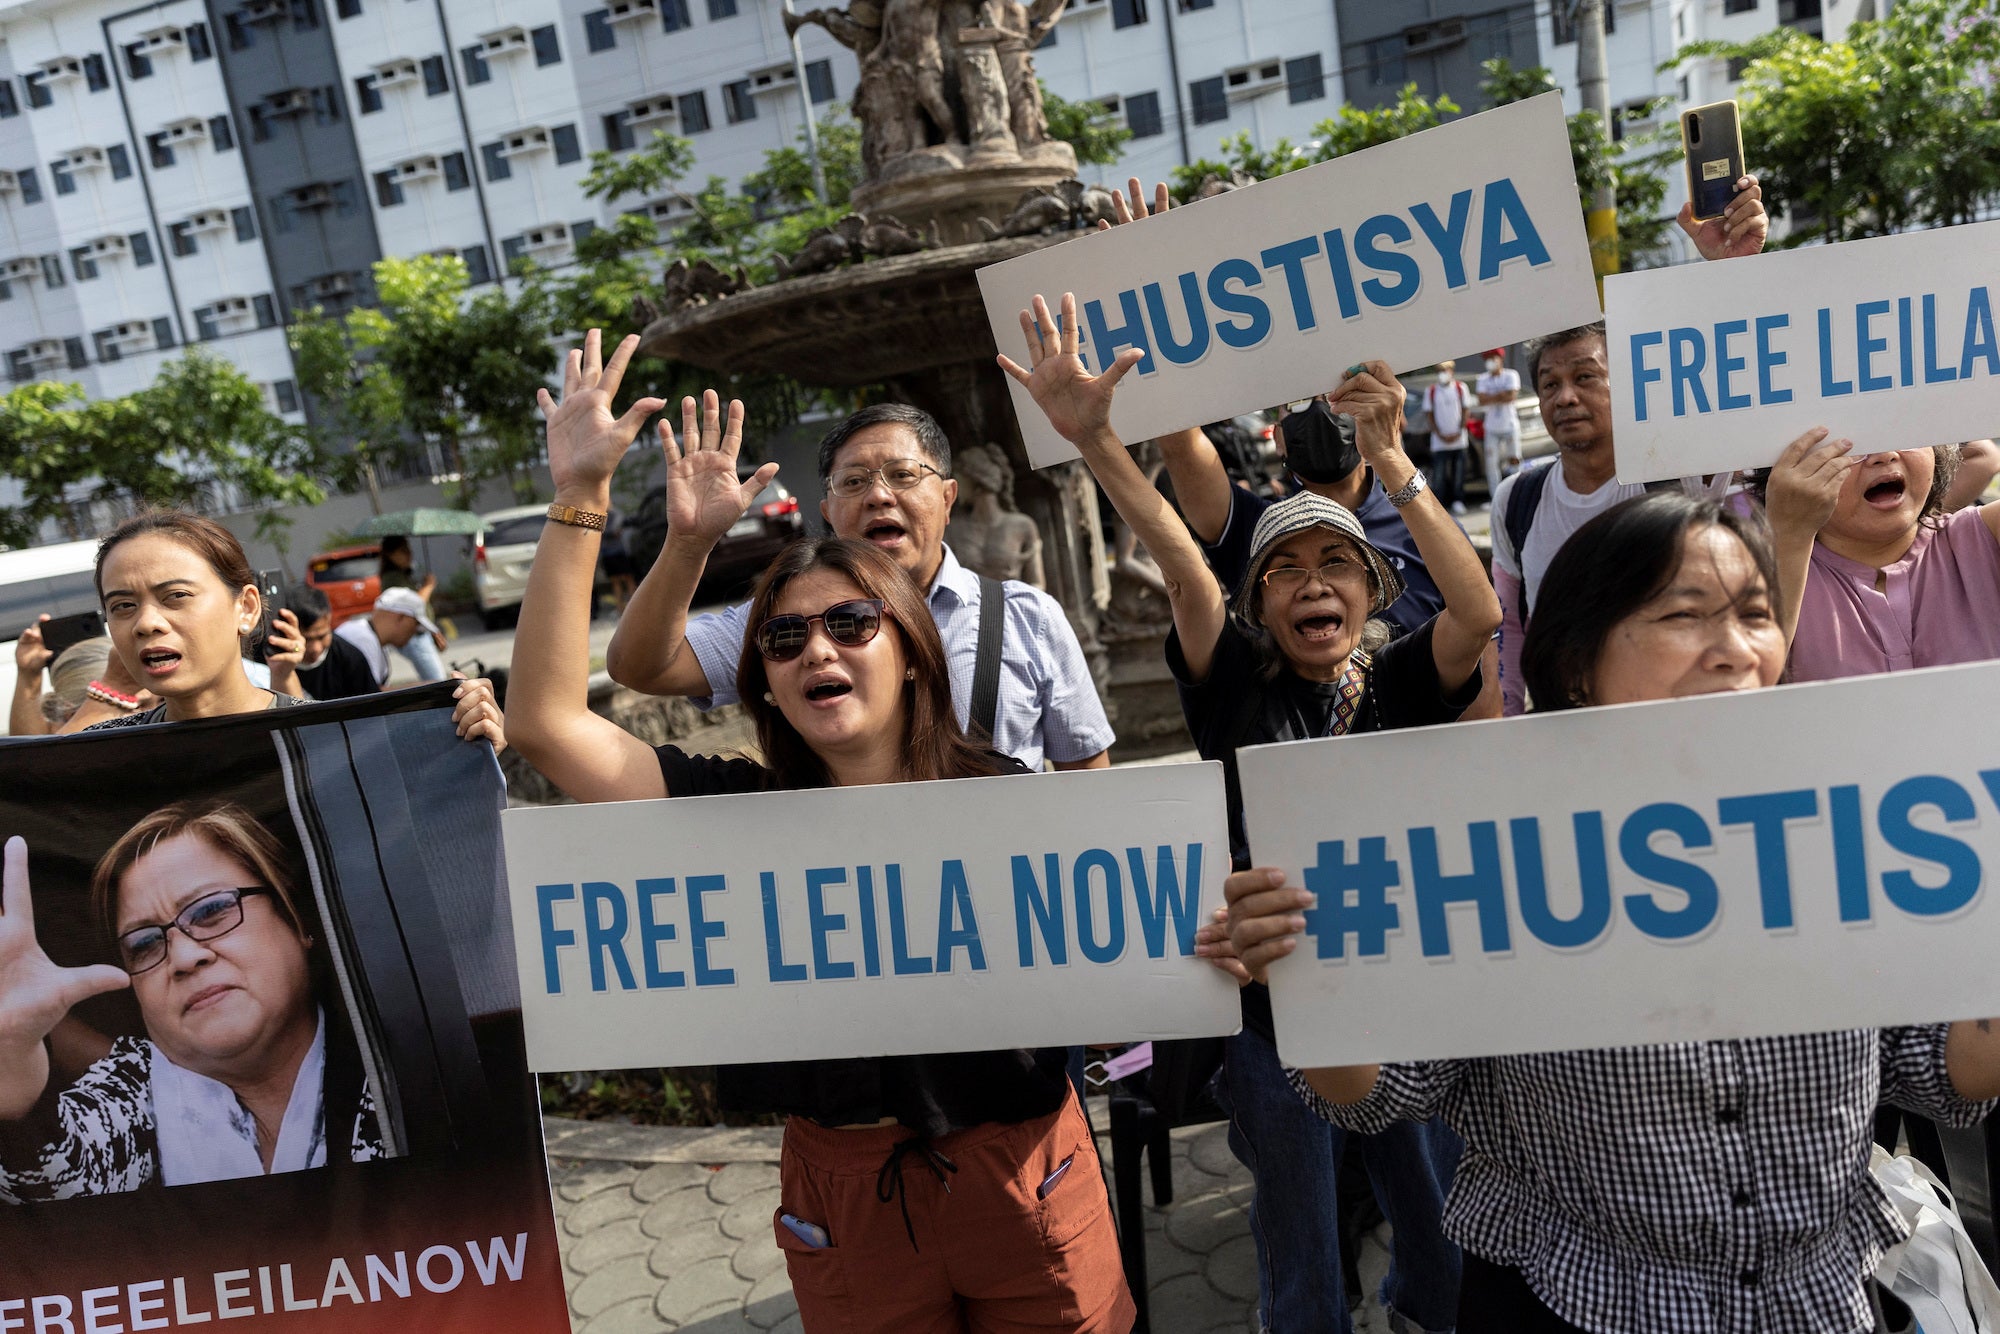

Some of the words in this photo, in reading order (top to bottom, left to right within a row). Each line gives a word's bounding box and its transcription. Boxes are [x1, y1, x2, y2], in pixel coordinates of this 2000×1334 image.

[1631, 314, 1794, 421] FREE
[1818, 287, 2000, 397] LEILA
[537, 874, 735, 994] FREE
[760, 859, 986, 982] LEILA
[1011, 843, 1202, 967] NOW
[1304, 770, 2000, 959] #HUSTIS
